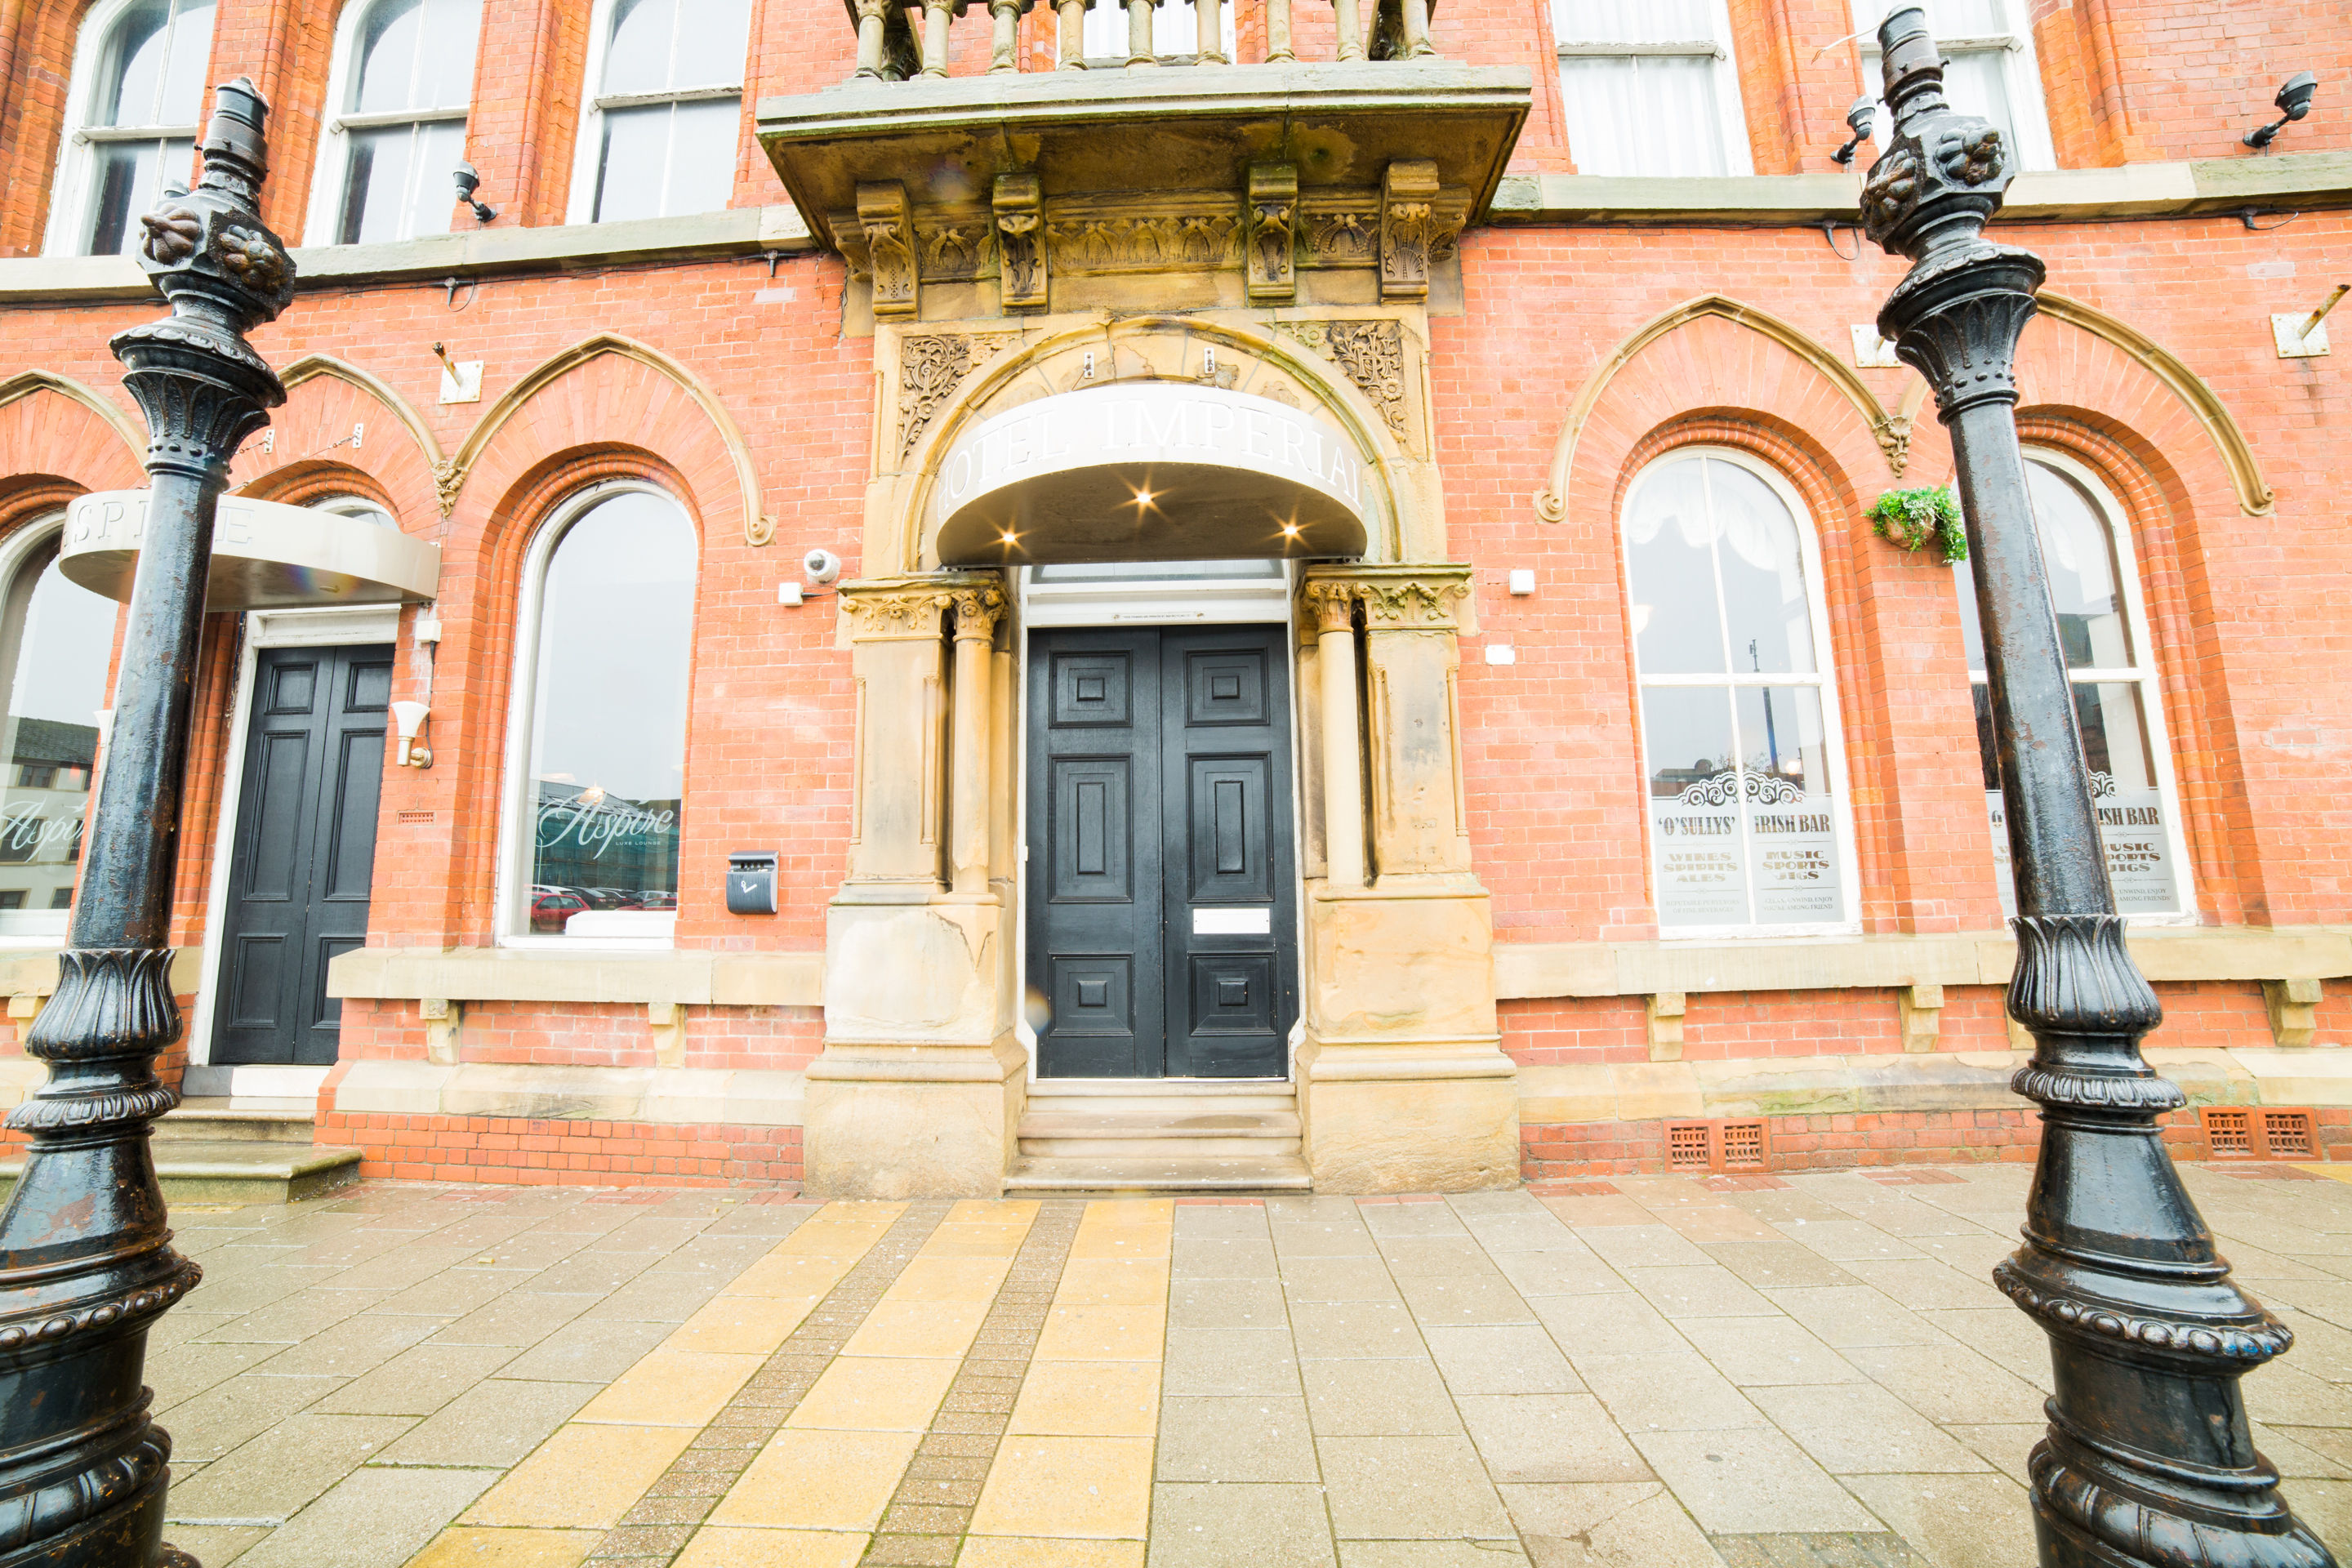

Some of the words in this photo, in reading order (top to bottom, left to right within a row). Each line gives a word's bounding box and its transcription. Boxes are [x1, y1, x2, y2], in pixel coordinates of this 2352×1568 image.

[1099, 398, 1363, 510] IMPERIAL
[2127, 807, 2159, 826] BAR
[536, 790, 675, 860] Aspire
[1754, 814, 1795, 834] IRISH
[1799, 813, 1830, 833] BAR
[1668, 852, 1731, 862] WINES
[1766, 850, 1824, 860] MUSIC
[2106, 853, 2161, 862] PORTS
[1663, 862, 1738, 872] SPIRITS
[1762, 860, 1829, 870] SPORTS
[1676, 873, 1726, 883] ALES
[1775, 871, 1820, 880] JIGS
